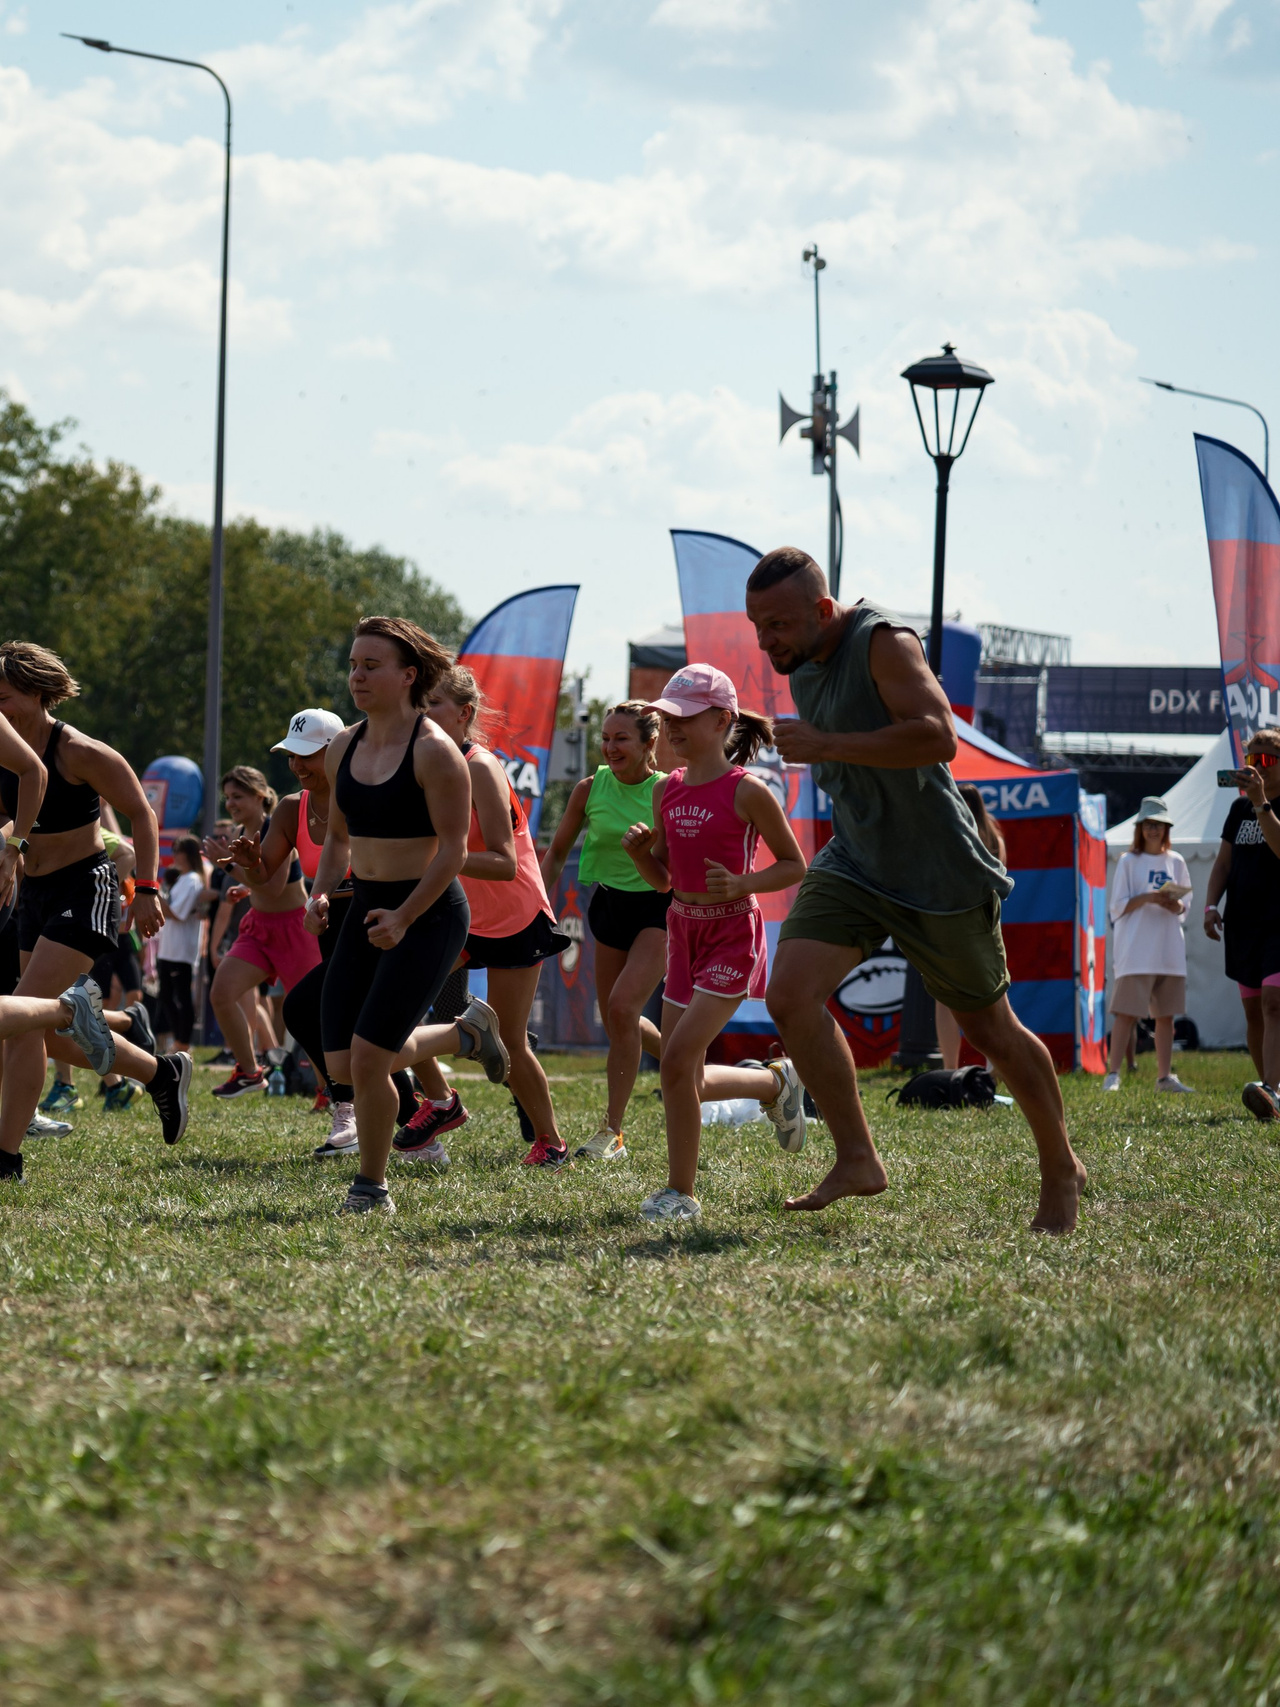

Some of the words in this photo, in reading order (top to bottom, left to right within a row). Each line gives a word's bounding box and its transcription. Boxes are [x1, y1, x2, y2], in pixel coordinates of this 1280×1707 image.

[1149, 689, 1200, 714] DDX
[291, 717, 306, 732] NY
[669, 805, 714, 822] HOLIDAY
[680, 819, 697, 827] VIBES
[690, 906, 726, 918] HOLIDAY
